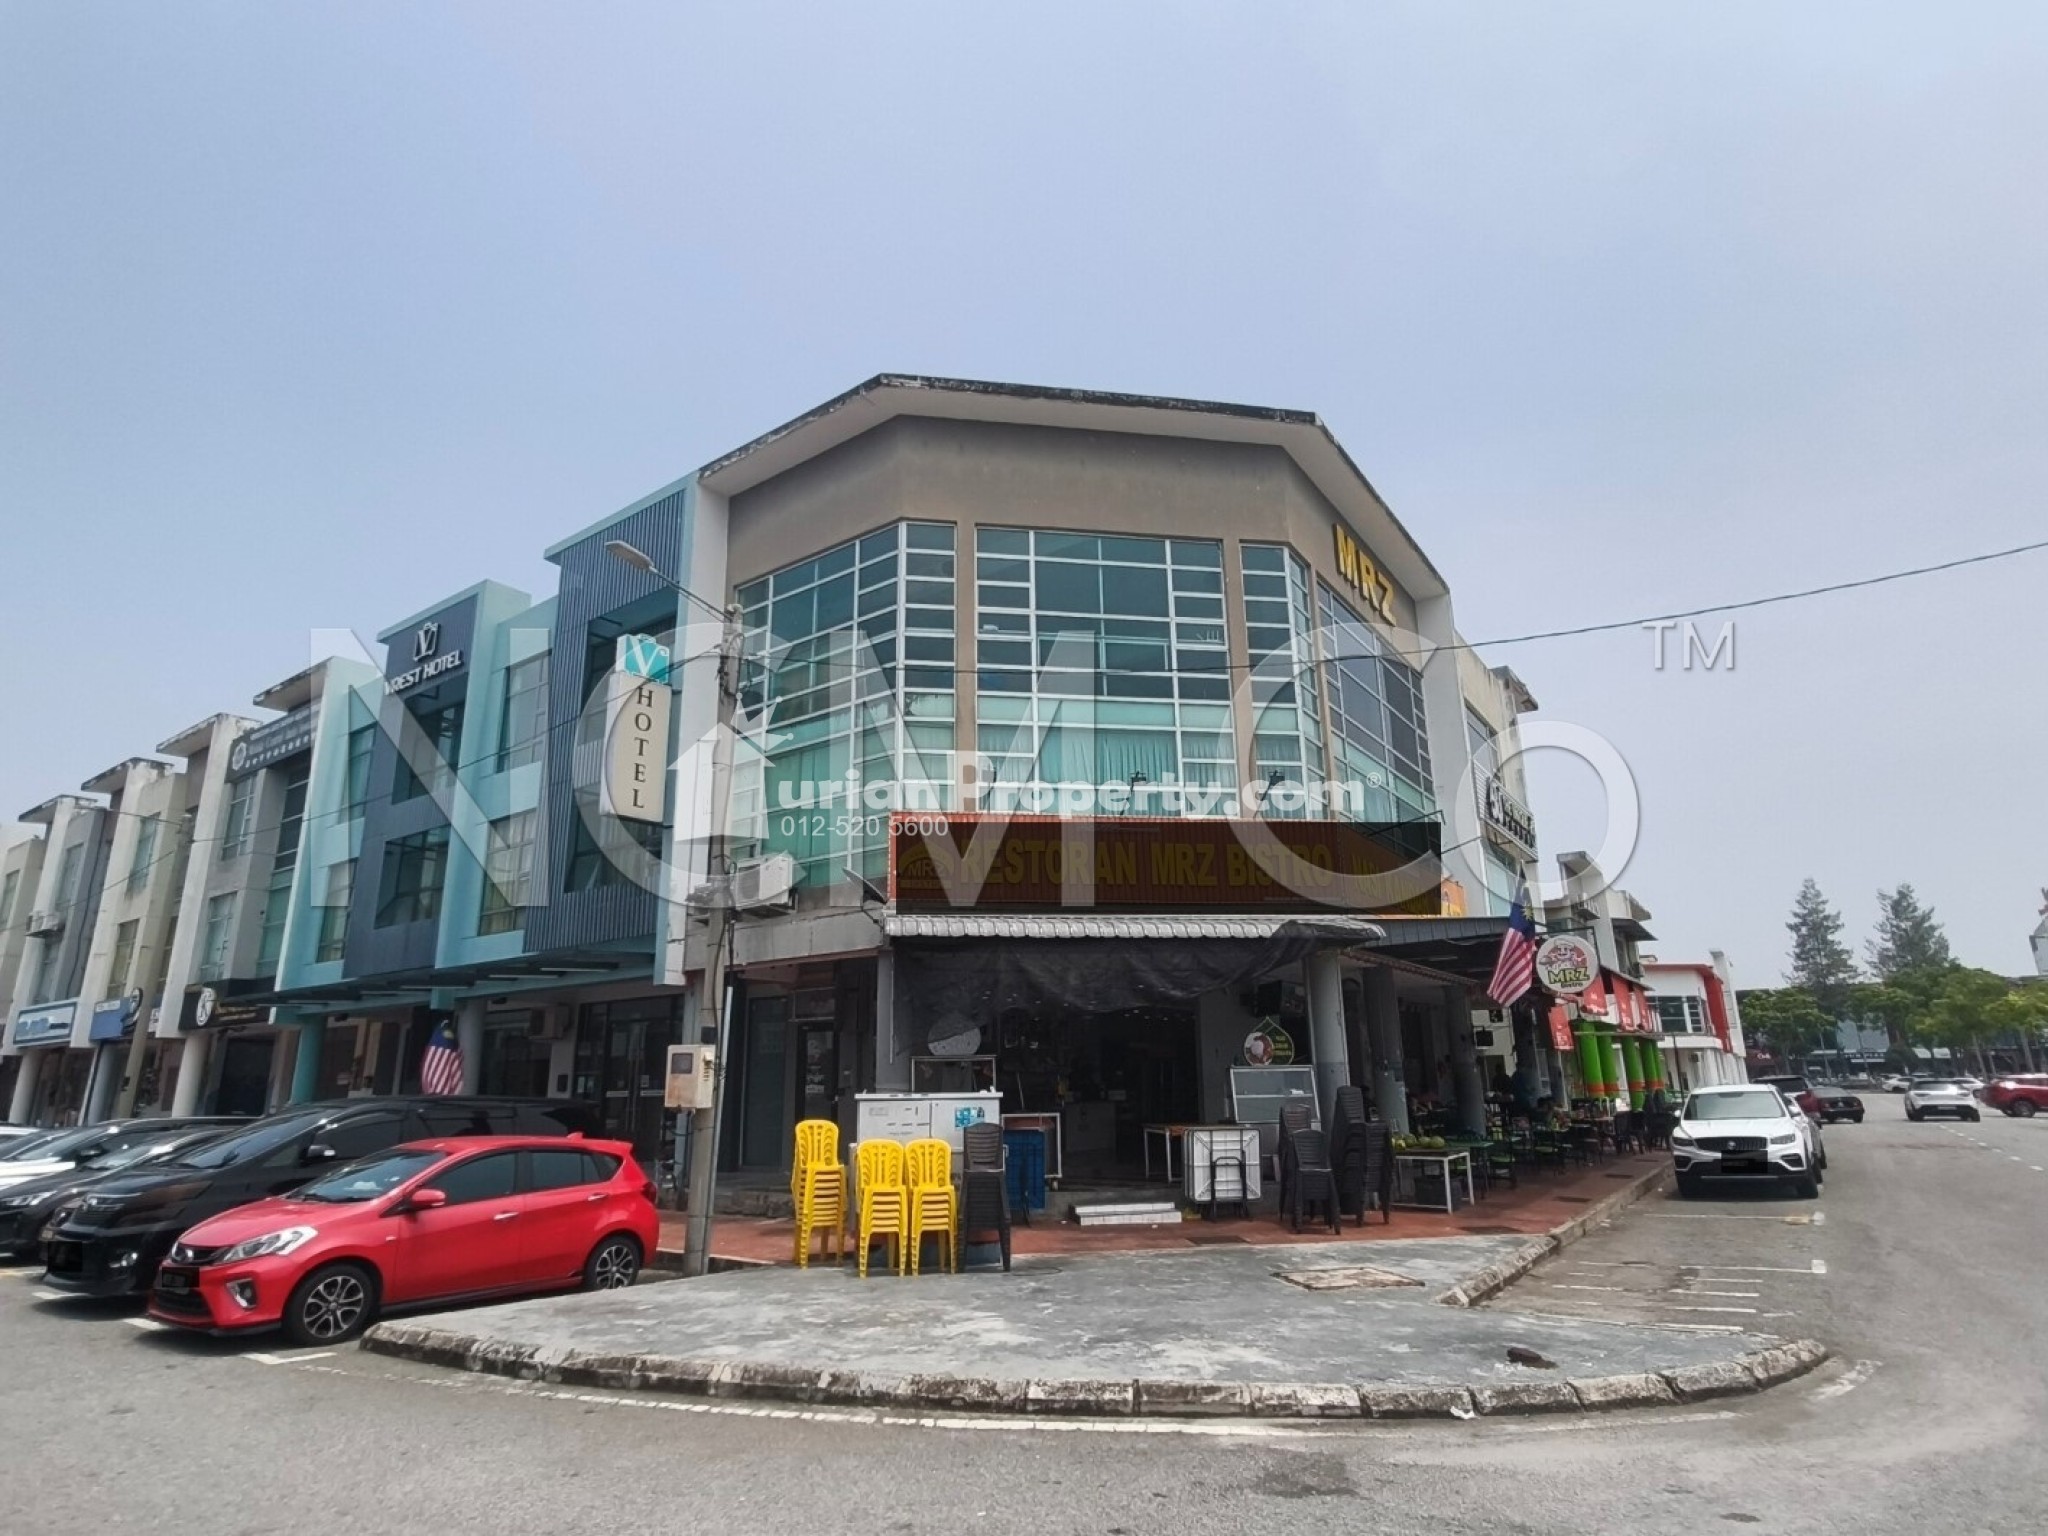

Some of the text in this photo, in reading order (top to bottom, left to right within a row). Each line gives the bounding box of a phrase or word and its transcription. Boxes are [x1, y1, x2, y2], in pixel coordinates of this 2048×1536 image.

[1332, 523, 1396, 627] MRZ
[423, 649, 462, 679] HOTEL
[632, 686, 654, 809] HOTEL
[960, 838, 1334, 888] RESTORAN MRZ BISTRO
[1548, 966, 1590, 984] MRZ
